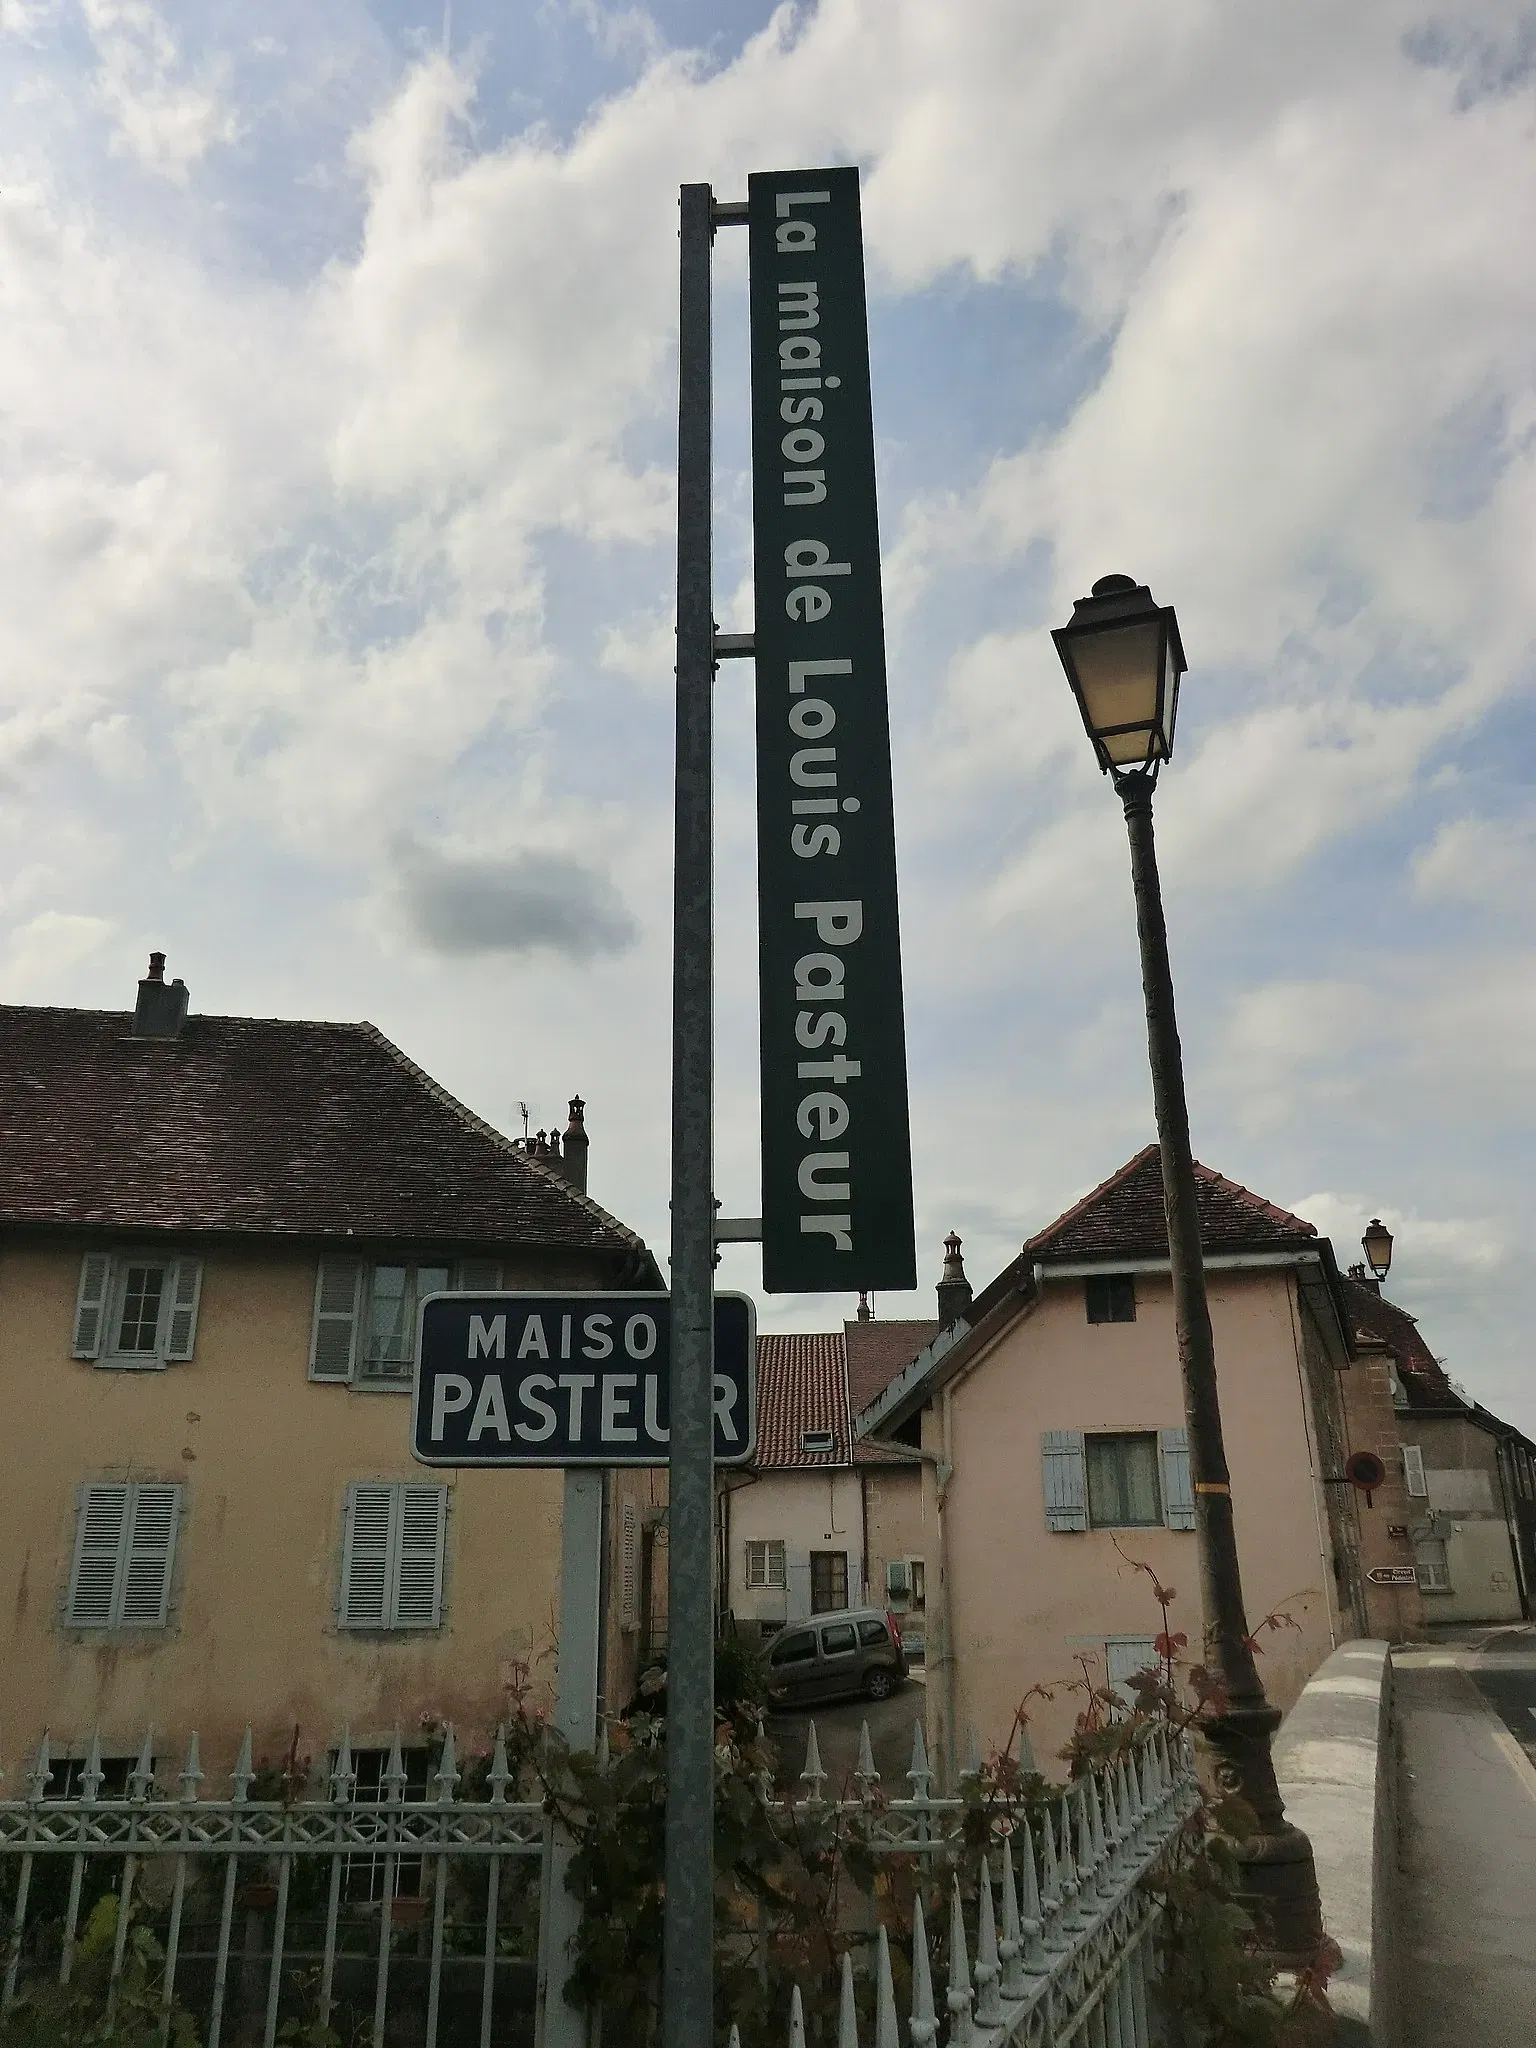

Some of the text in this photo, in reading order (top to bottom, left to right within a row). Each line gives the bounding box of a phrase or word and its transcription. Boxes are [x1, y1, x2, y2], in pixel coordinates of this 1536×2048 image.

[775, 190, 863, 1251] La maison de Louis Pasteur
[467, 1313, 657, 1360] MAISO
